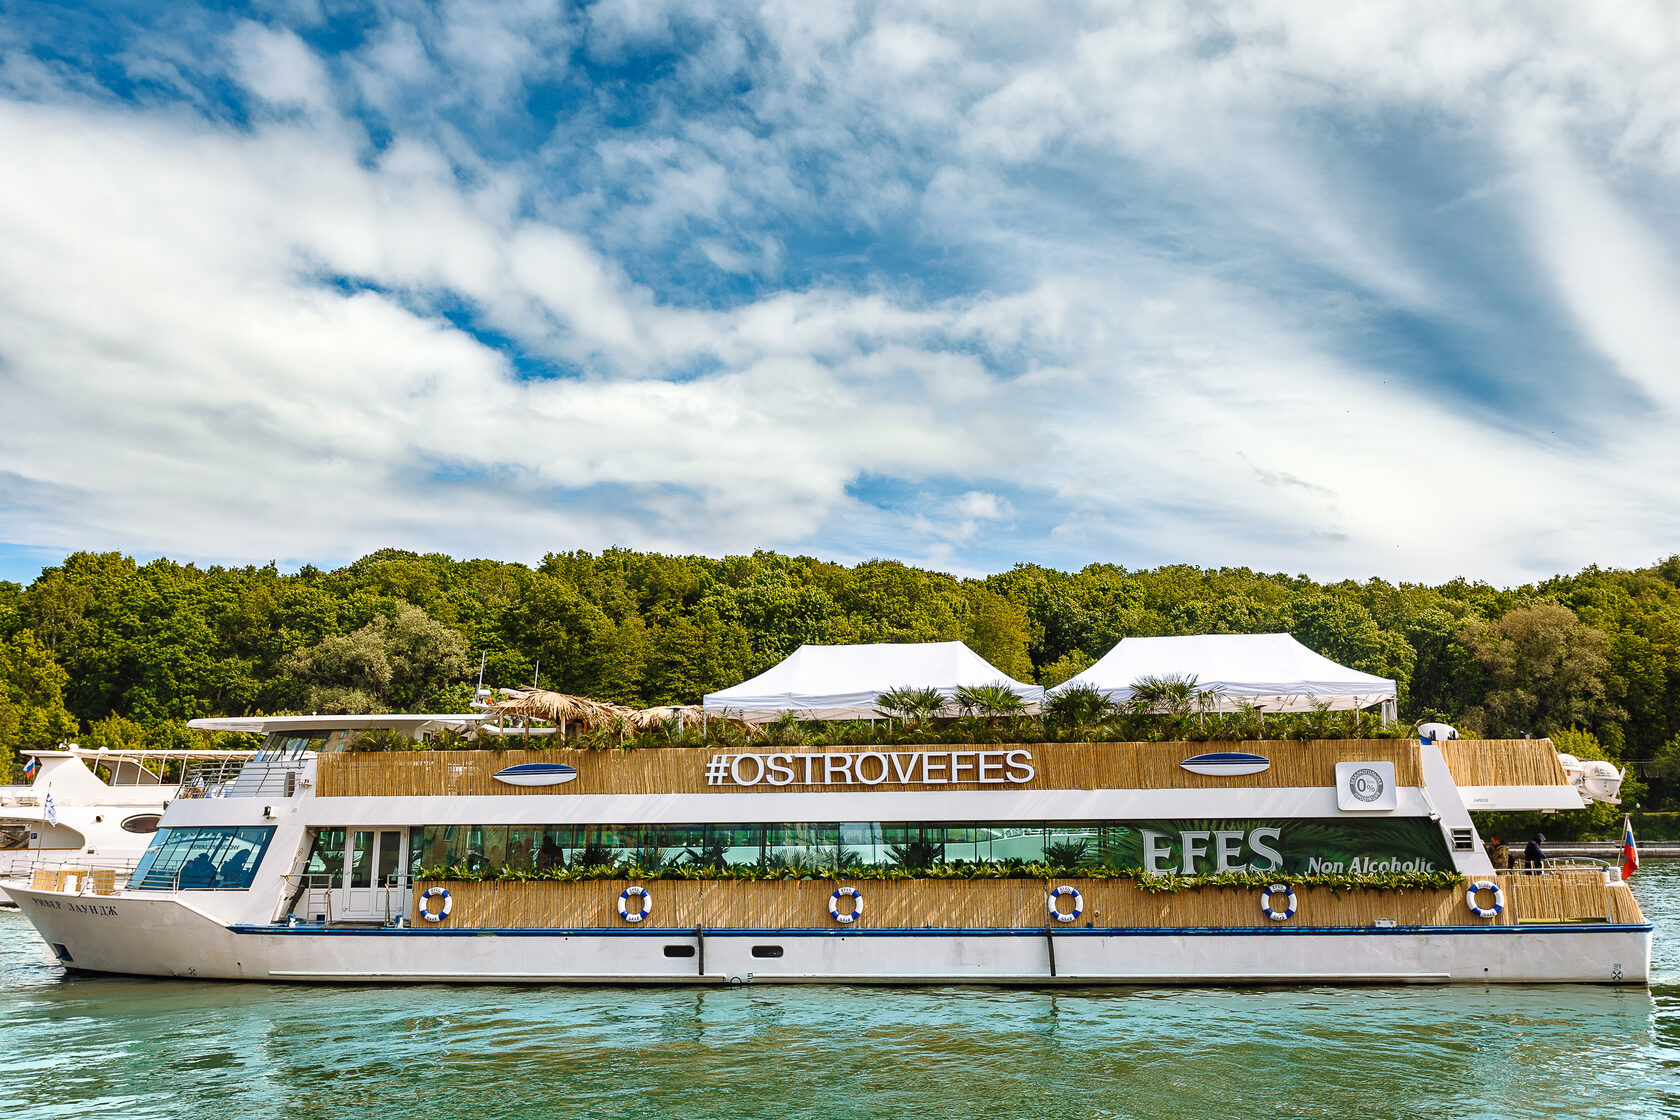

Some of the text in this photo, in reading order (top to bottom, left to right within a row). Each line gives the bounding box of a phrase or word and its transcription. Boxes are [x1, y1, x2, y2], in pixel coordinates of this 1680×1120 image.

[705, 750, 1035, 786] #OSTROVEFES
[1140, 827, 1284, 877] EFES
[1308, 856, 1435, 874] Non Alcoholic
[32, 897, 118, 916] РИВЕР ЛАУНДЖ
